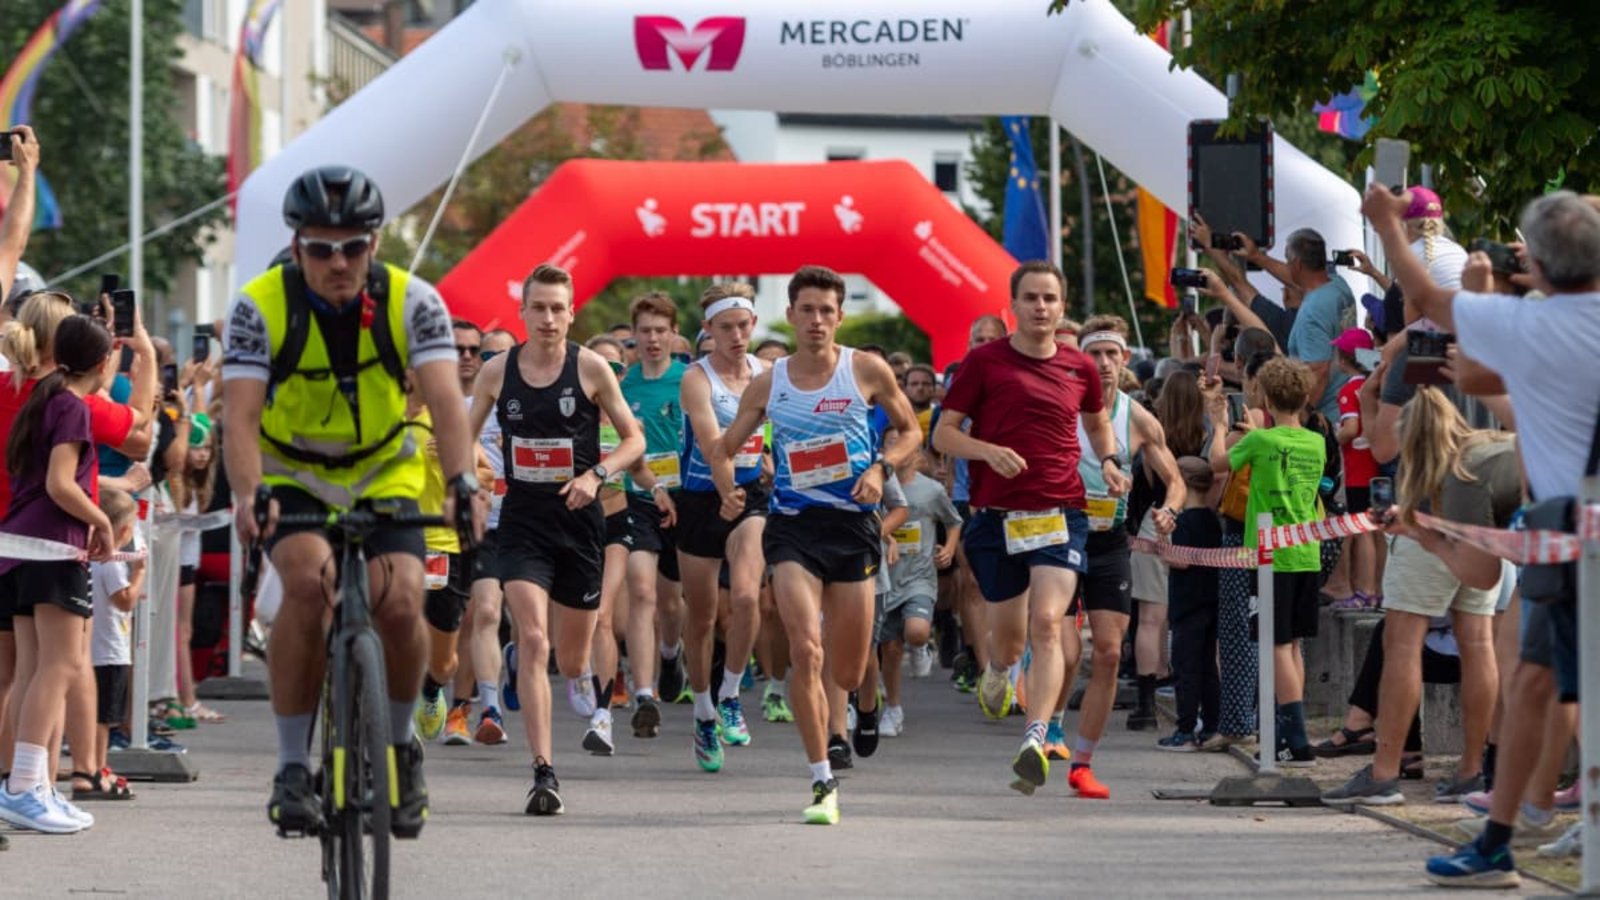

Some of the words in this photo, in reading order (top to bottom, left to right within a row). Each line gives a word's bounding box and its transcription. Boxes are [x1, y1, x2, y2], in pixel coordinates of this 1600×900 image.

[780, 18, 964, 45] MERCADEN
[821, 52, 920, 68] BÖBLINGEN
[690, 201, 806, 238] START
